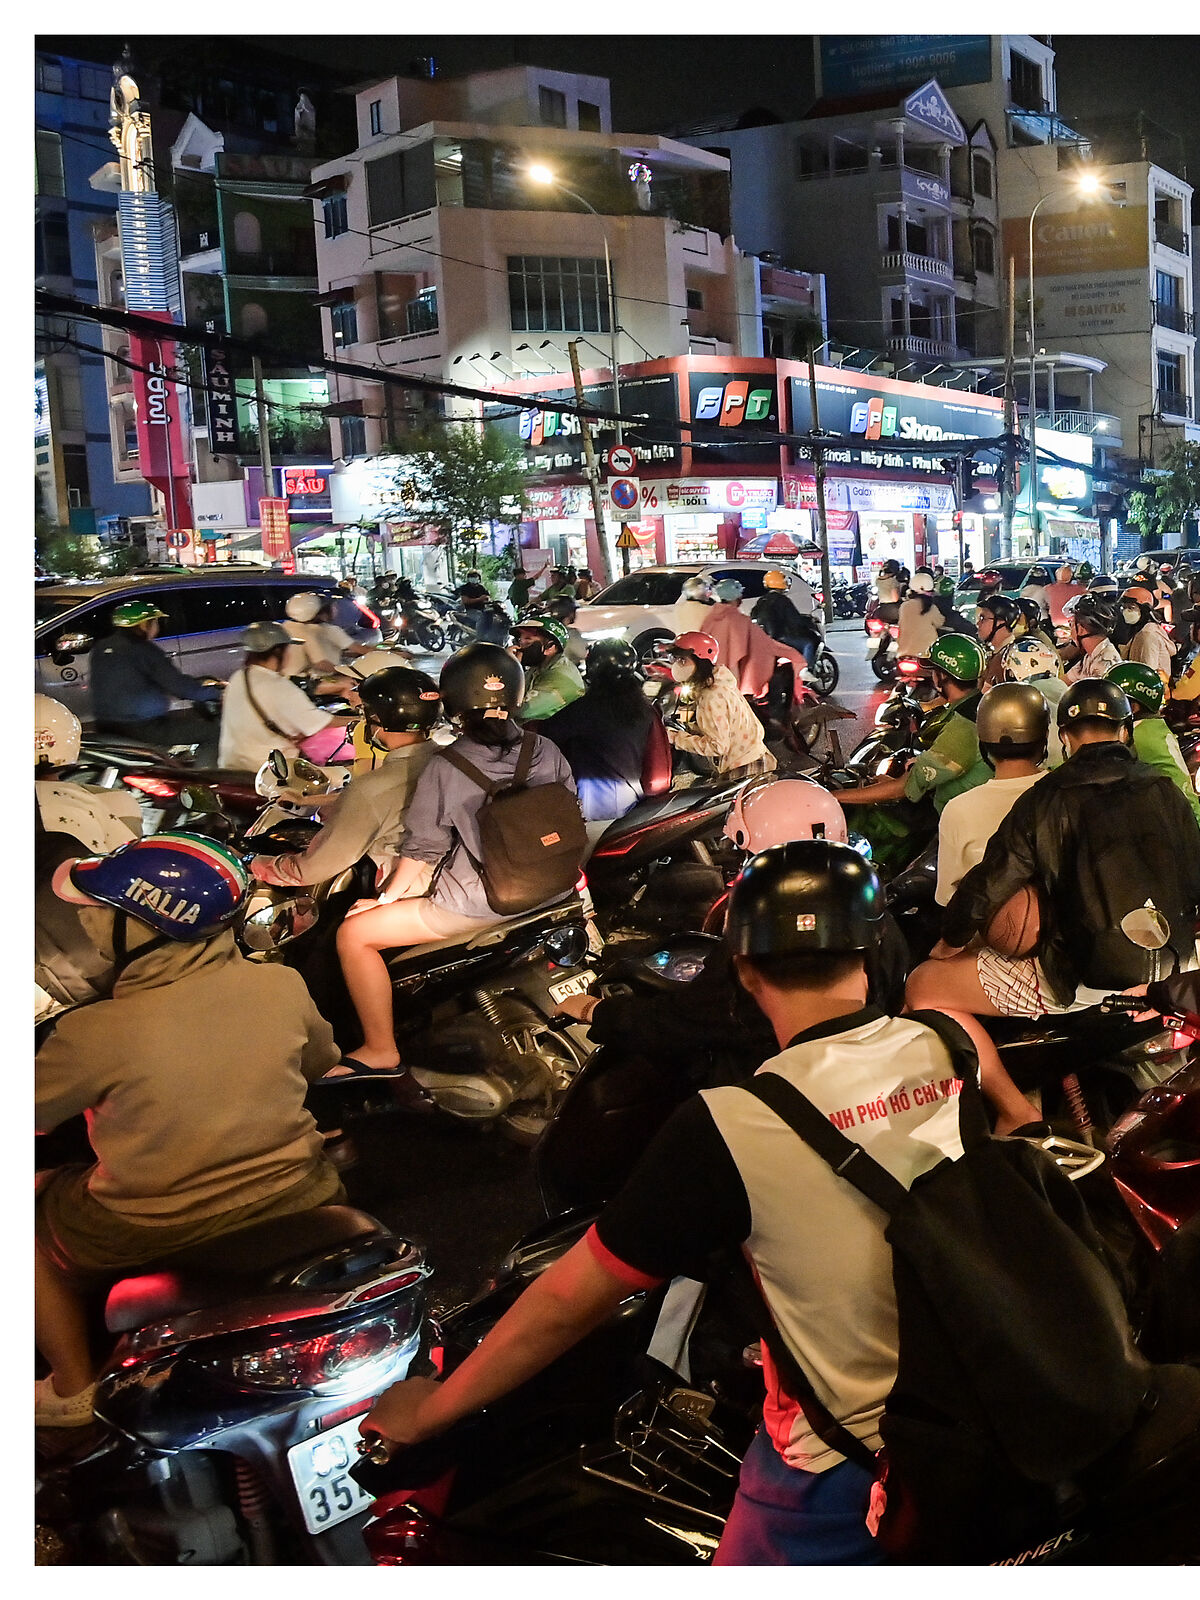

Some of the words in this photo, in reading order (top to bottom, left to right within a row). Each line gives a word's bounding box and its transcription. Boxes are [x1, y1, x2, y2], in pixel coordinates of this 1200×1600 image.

[549, 622, 566, 637] Grab
[937, 650, 958, 668] Grab
[1135, 682, 1160, 700] Grab
[124, 877, 202, 926] ITALIA
[858, 1091, 888, 1124] PHỐ
[888, 1087, 912, 1114] HỒ
[914, 1080, 940, 1108] CHÍ
[939, 1078, 966, 1100] MIN
